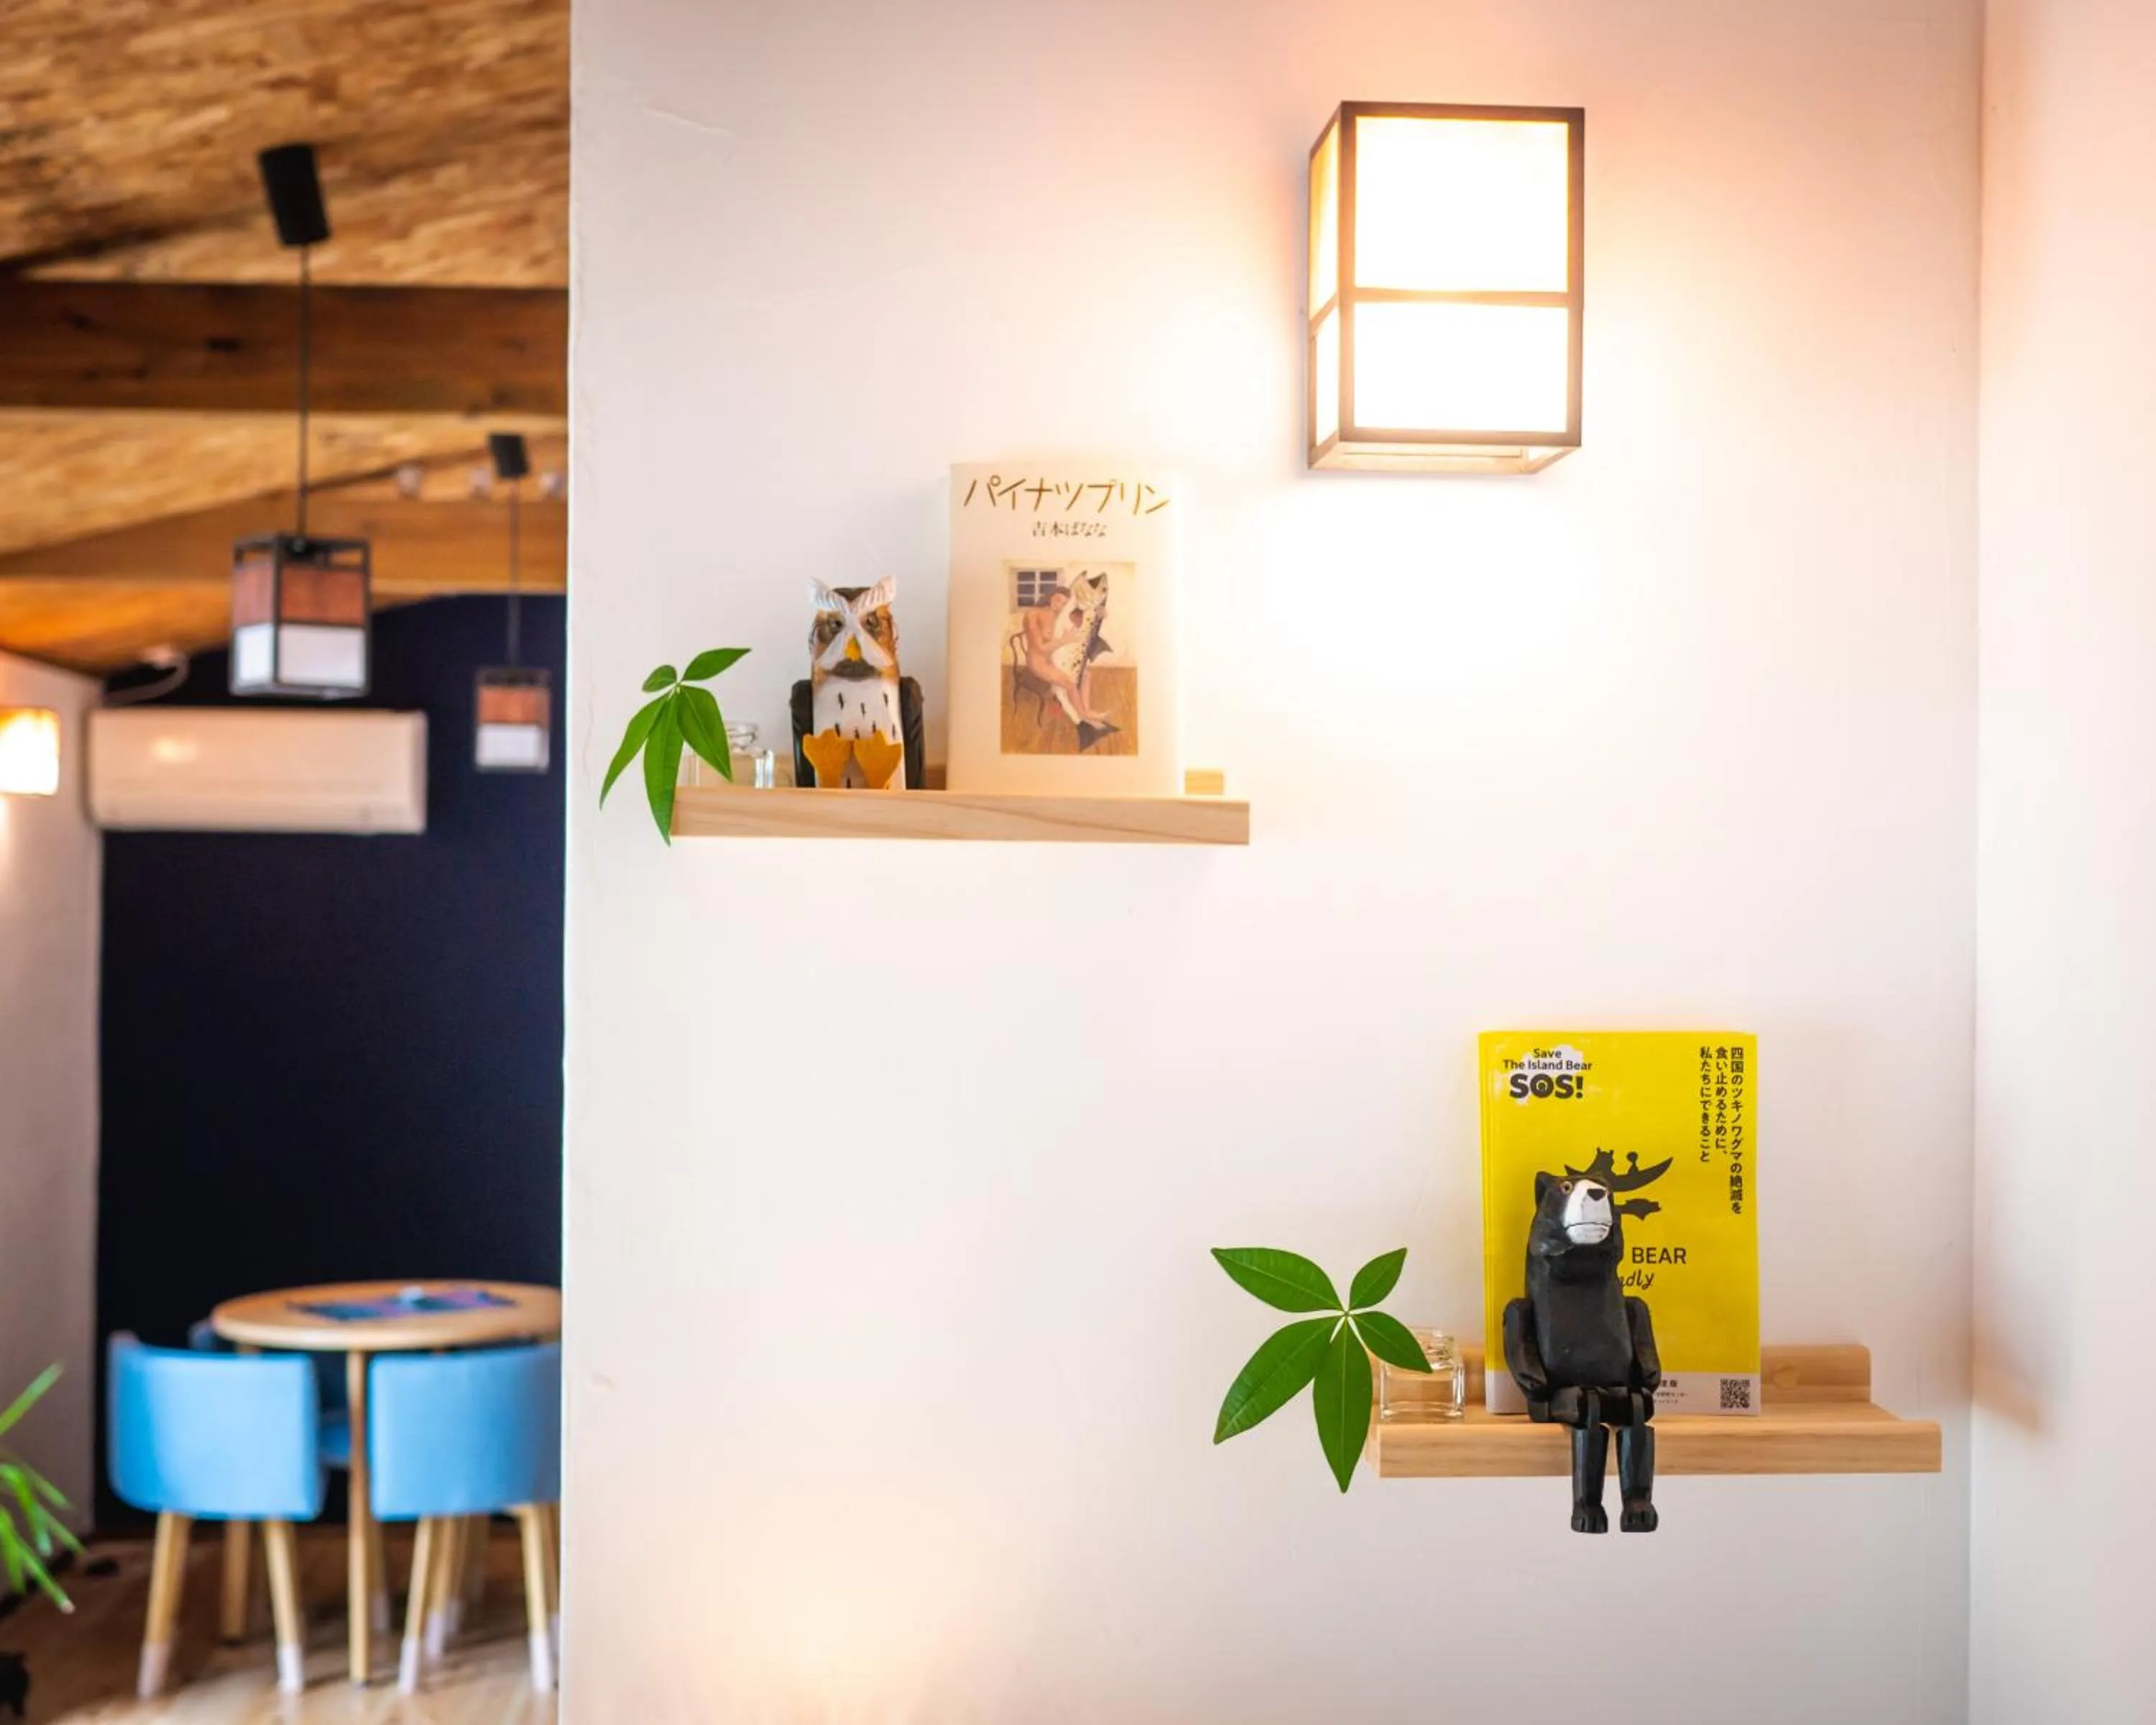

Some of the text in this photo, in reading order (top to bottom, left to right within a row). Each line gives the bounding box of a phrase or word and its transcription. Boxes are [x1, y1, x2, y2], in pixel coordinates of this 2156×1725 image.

[1532, 1047, 1562, 1059] Save
[1503, 1059, 1593, 1070] The Island Bear
[1509, 1072, 1584, 1099] SOS!
[1699, 1046, 1713, 1163] 私たちにできること
[1632, 1247, 1687, 1264] BEAR
